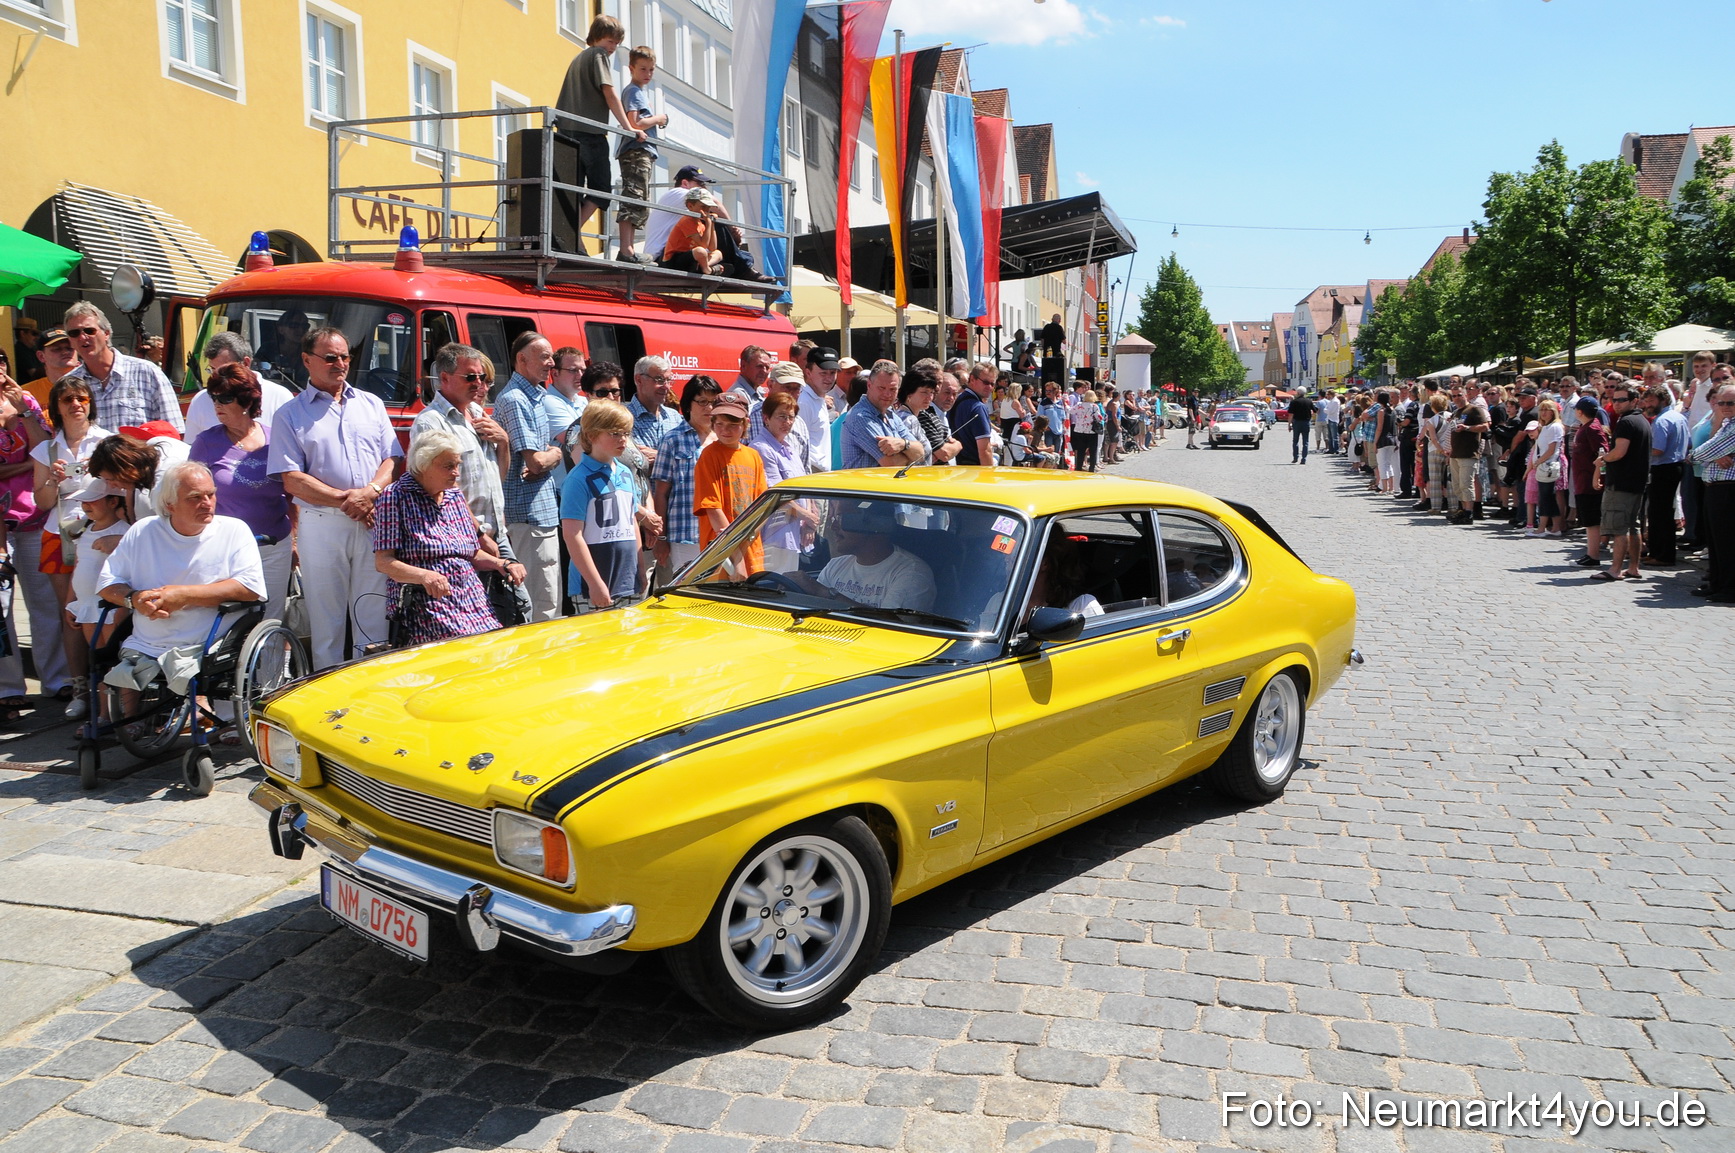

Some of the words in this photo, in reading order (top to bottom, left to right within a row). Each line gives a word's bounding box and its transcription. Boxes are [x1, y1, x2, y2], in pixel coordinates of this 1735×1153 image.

[1098, 302, 1109, 356] HOTEL
[998, 542, 1007, 551] 10
[935, 799, 957, 815] V8
[338, 879, 360, 921] NM
[370, 897, 418, 948] 0756
